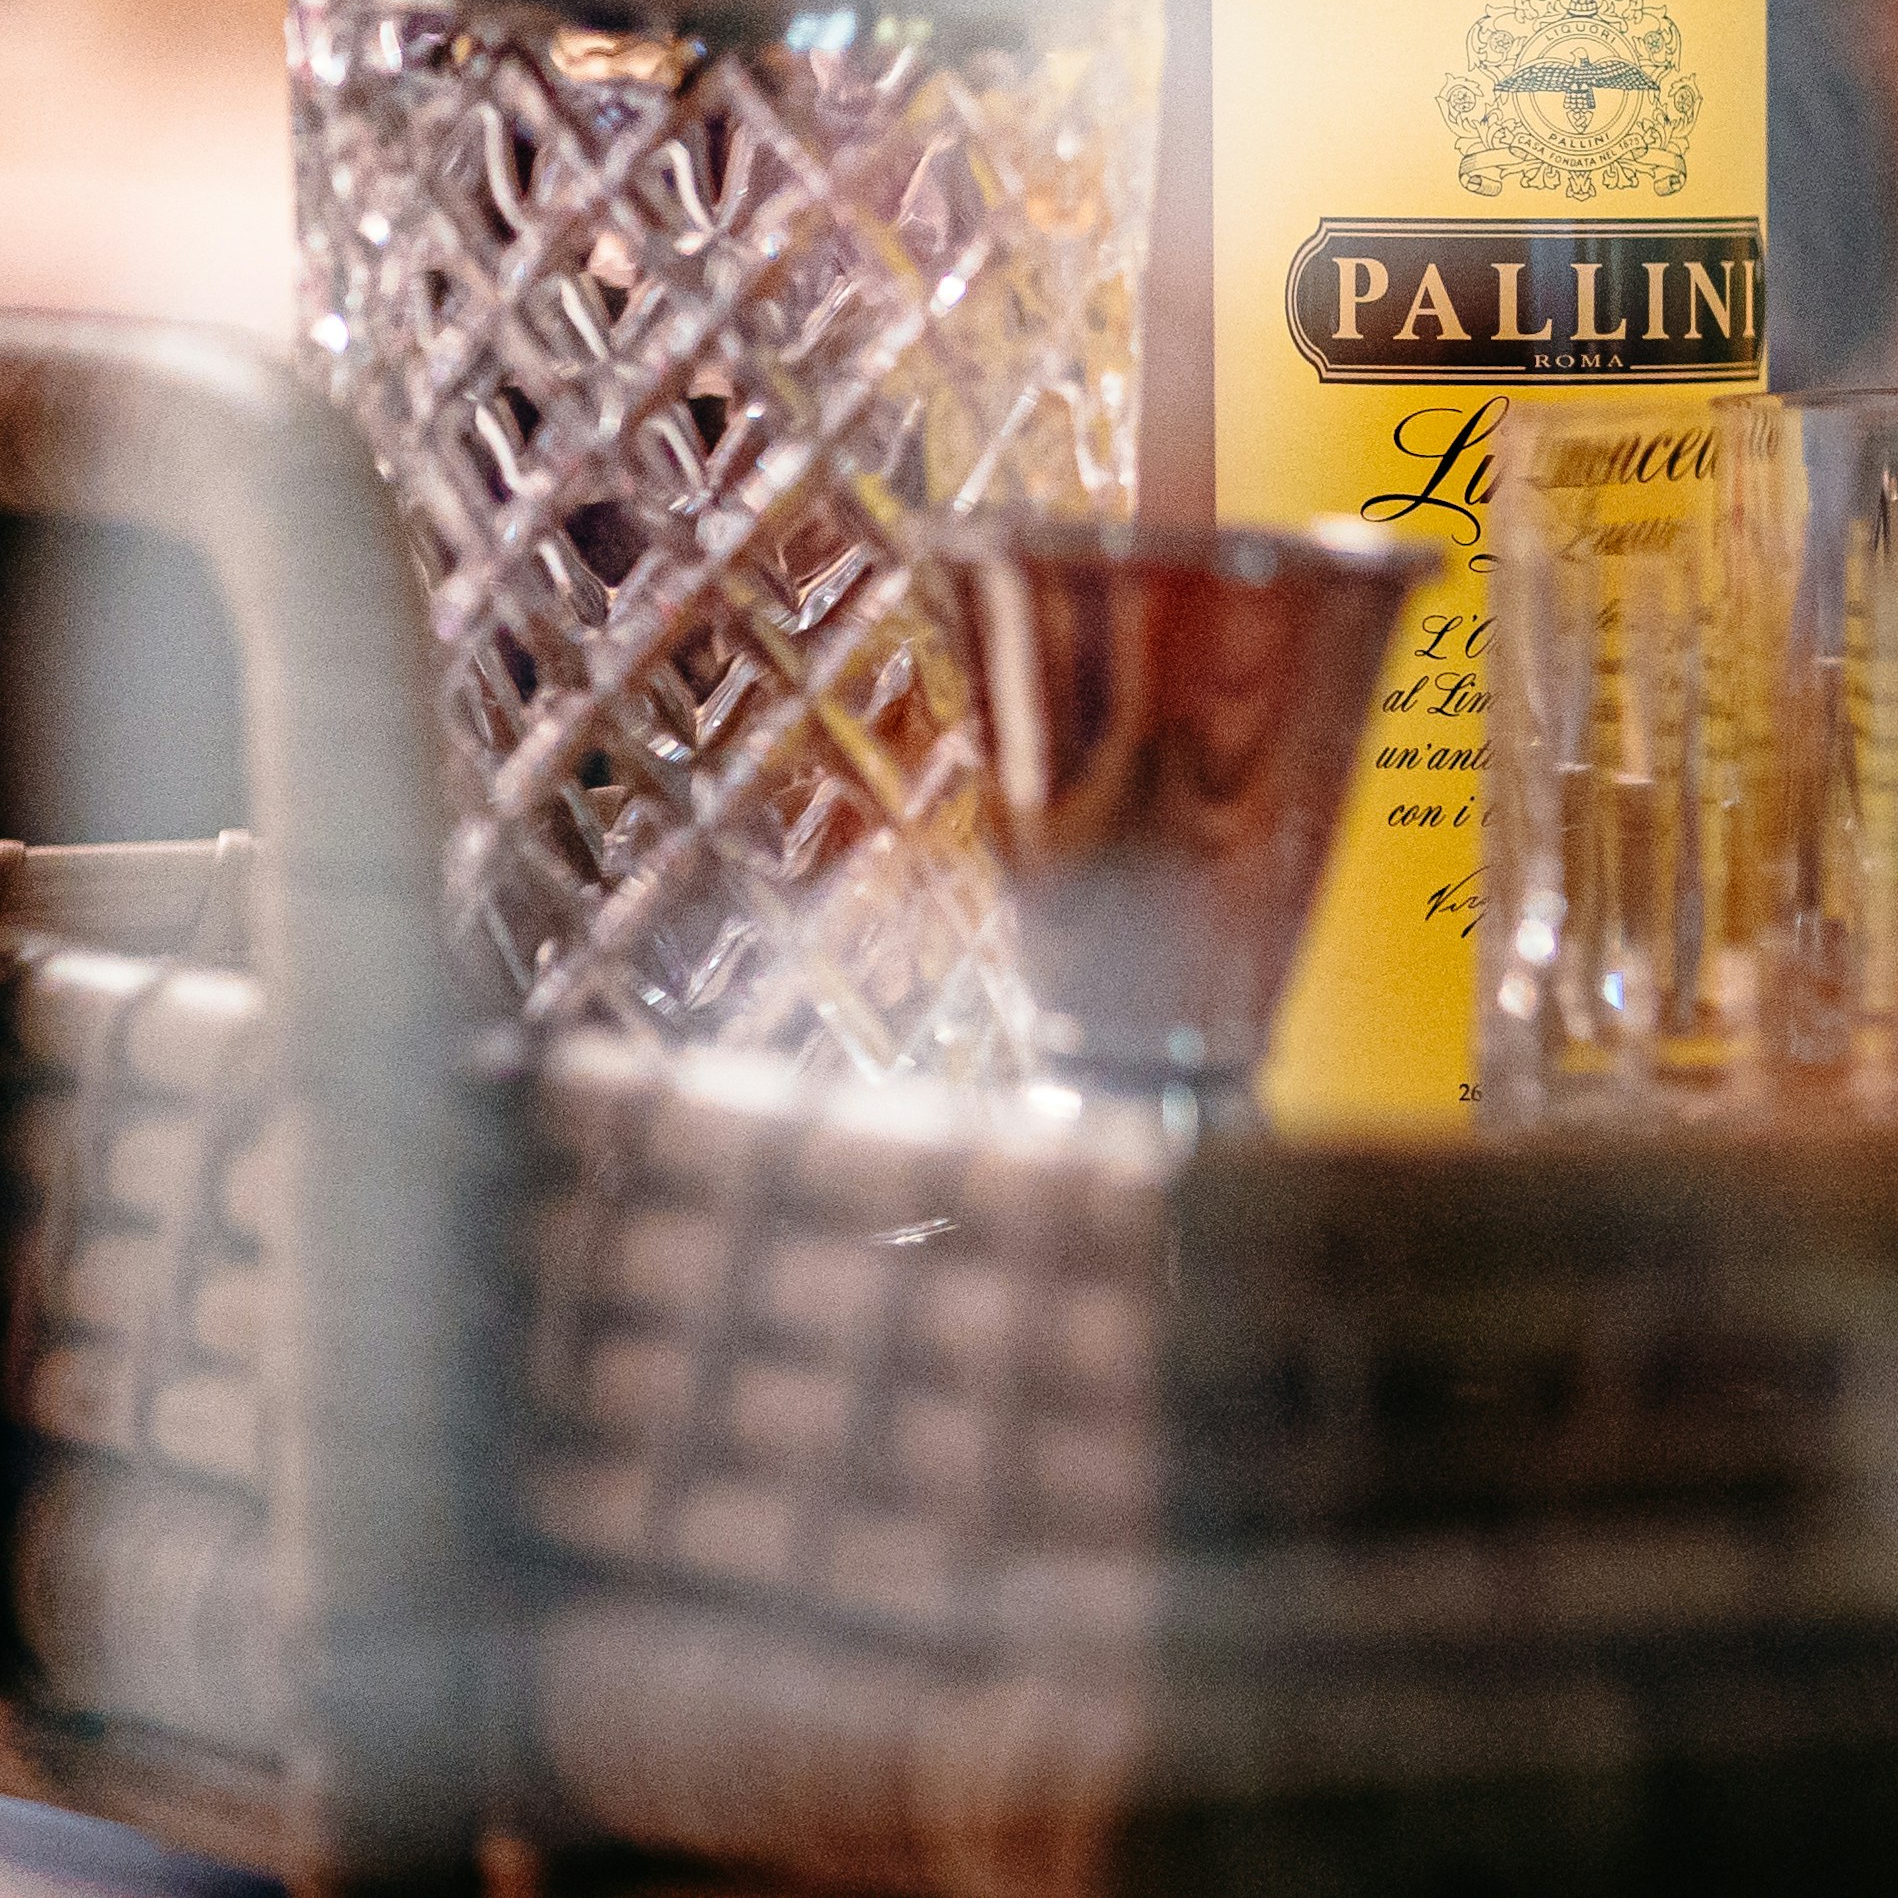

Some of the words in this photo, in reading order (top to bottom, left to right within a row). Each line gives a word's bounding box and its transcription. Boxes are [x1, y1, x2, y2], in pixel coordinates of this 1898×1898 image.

[1544, 22, 1617, 44] LIQUORI
[1517, 134, 1546, 155] CASA
[1548, 151, 1598, 168] FONDATA
[1599, 148, 1618, 163] NEL
[1547, 132, 1611, 149] PALLINI
[1331, 255, 1757, 341] PALLINI
[1533, 352, 1625, 369] ROMA
[1382, 675, 1429, 713] al
[1387, 804, 1446, 828] con
